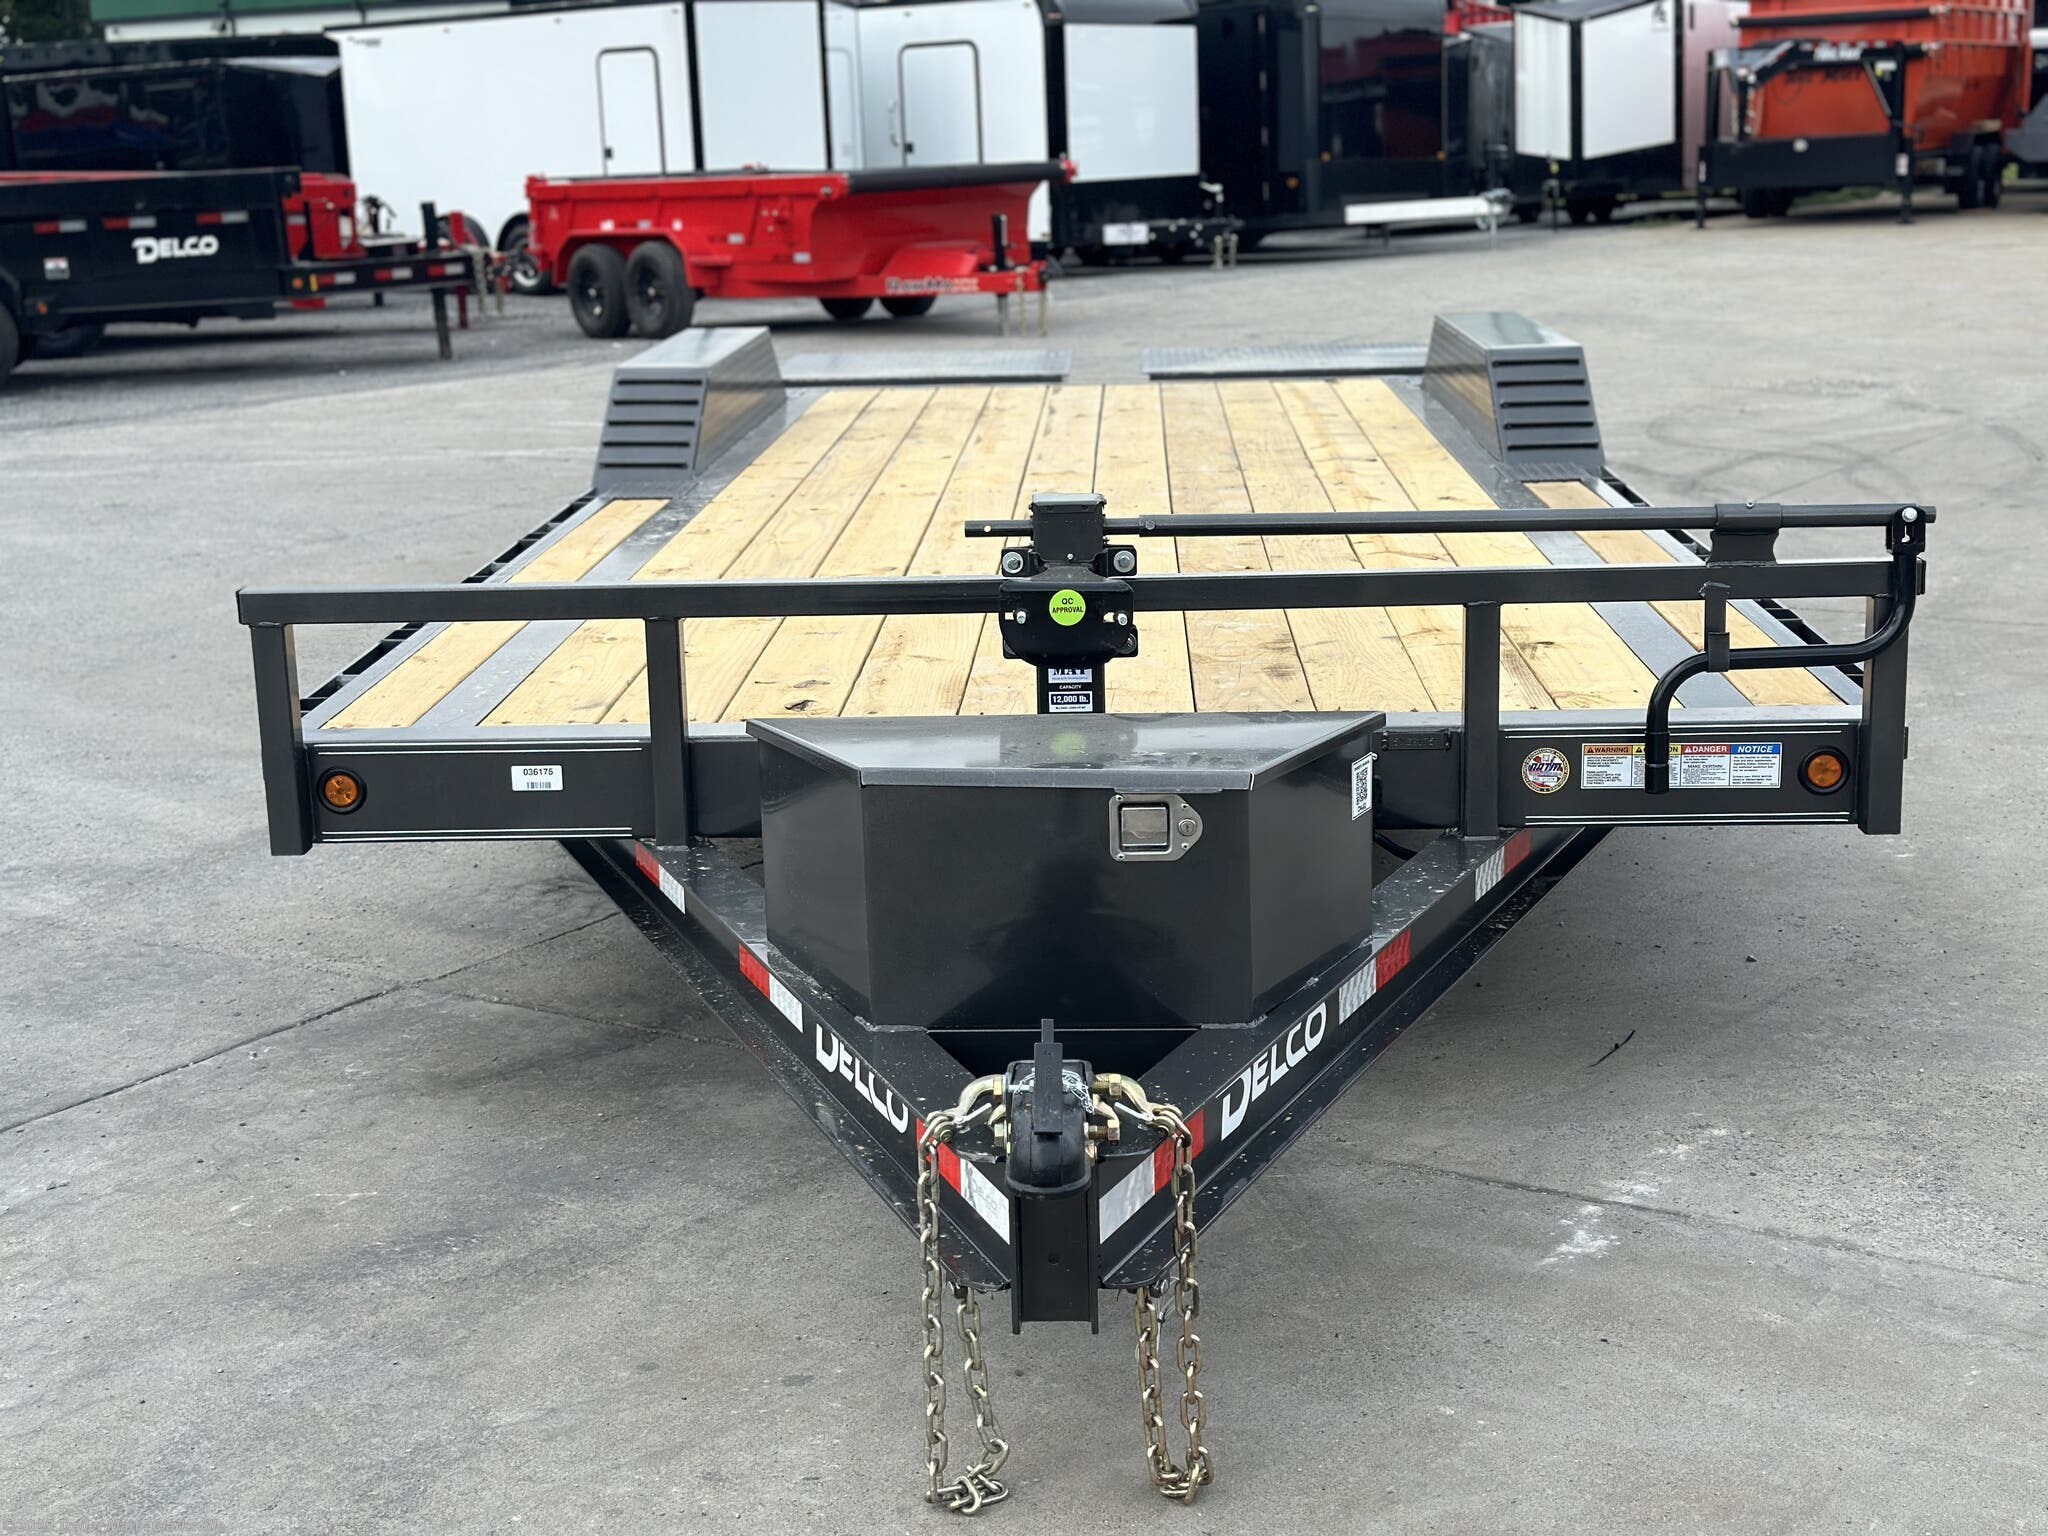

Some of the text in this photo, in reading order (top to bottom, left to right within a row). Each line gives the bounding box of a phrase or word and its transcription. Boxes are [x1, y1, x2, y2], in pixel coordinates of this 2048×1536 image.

[131, 235, 219, 264] DELCO
[1052, 695, 1078, 704] 12,000
[1692, 745, 1727, 753] DANGER
[1737, 745, 1773, 753] NOTICE
[523, 768, 554, 776] 036175
[1215, 1001, 1327, 1142] DELCO
[815, 1023, 909, 1134] DELCO
